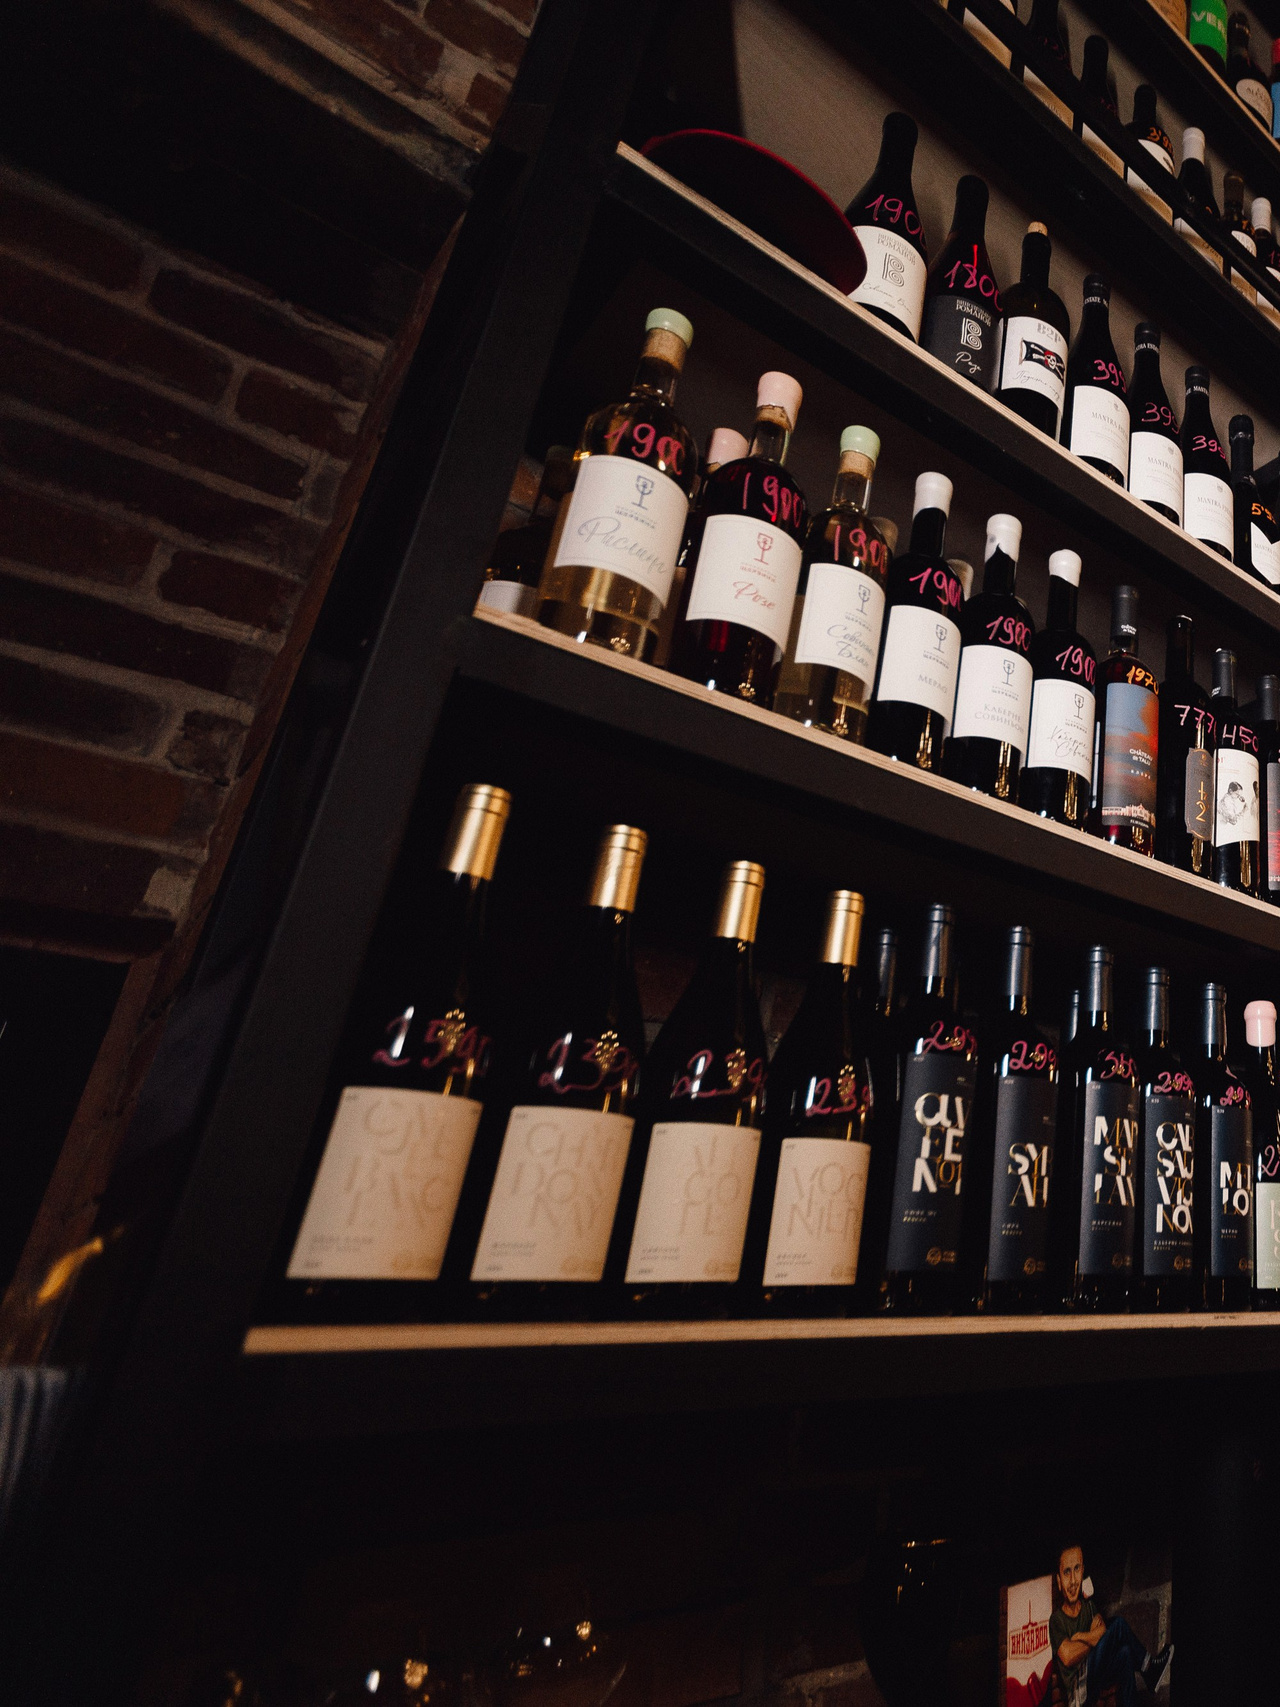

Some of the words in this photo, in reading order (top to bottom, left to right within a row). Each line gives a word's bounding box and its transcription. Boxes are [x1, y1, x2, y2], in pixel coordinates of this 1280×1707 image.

[1091, 411, 1117, 429] MANTRA
[1148, 456, 1171, 472] MANTRA
[1197, 496, 1221, 512] MANTRA
[733, 580, 777, 611] Розе
[918, 673, 948, 694] МЕРЛО
[984, 703, 1022, 722] КАБЕРНЕ
[1010, 1624, 1049, 1656] ВИНЗАВОД
